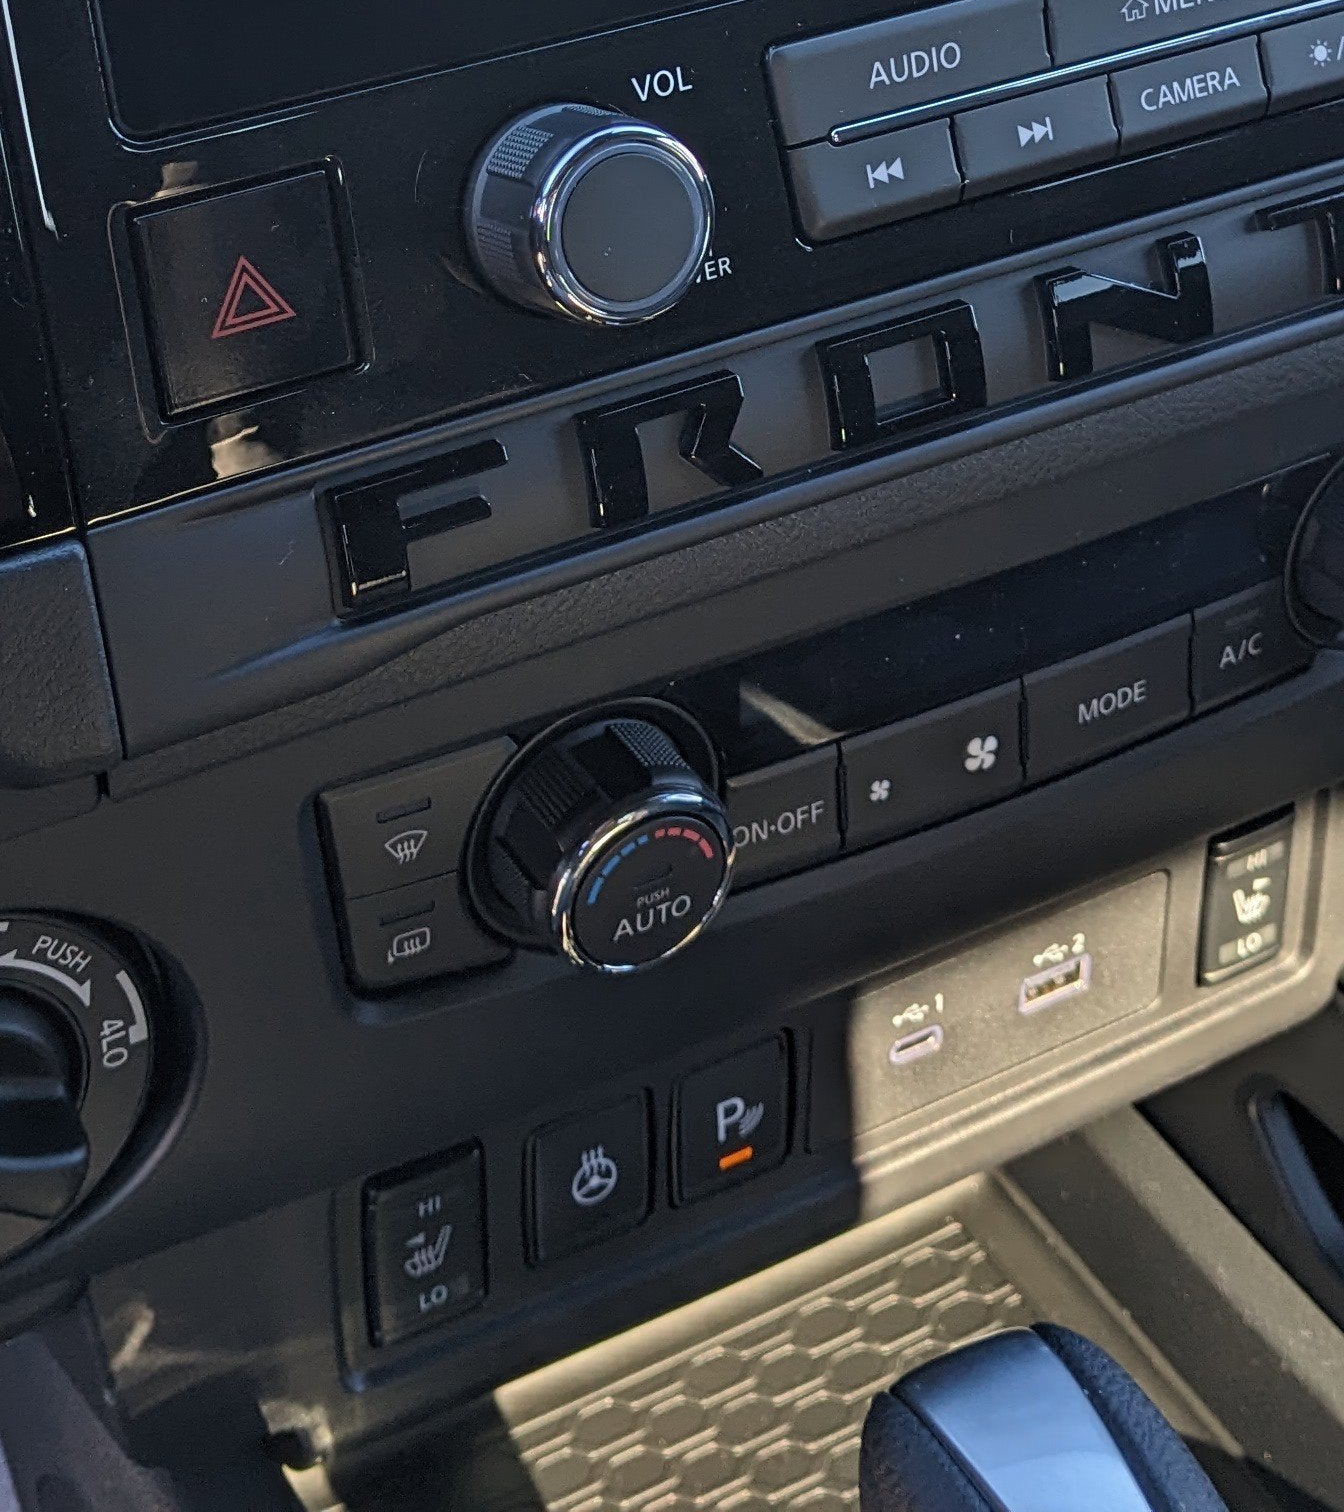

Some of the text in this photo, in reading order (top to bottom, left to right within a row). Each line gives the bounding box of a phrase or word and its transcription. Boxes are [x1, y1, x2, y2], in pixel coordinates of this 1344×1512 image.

[630, 65, 693, 103] VOL
[867, 41, 963, 90] AUDIO
[1139, 66, 1241, 112] CAMERA
[1218, 631, 1265, 670] A/C
[1076, 678, 1148, 724] MODE
[612, 894, 692, 942] AUTO
[31, 934, 93, 973] PUSH
[419, 1284, 448, 1313] LO
